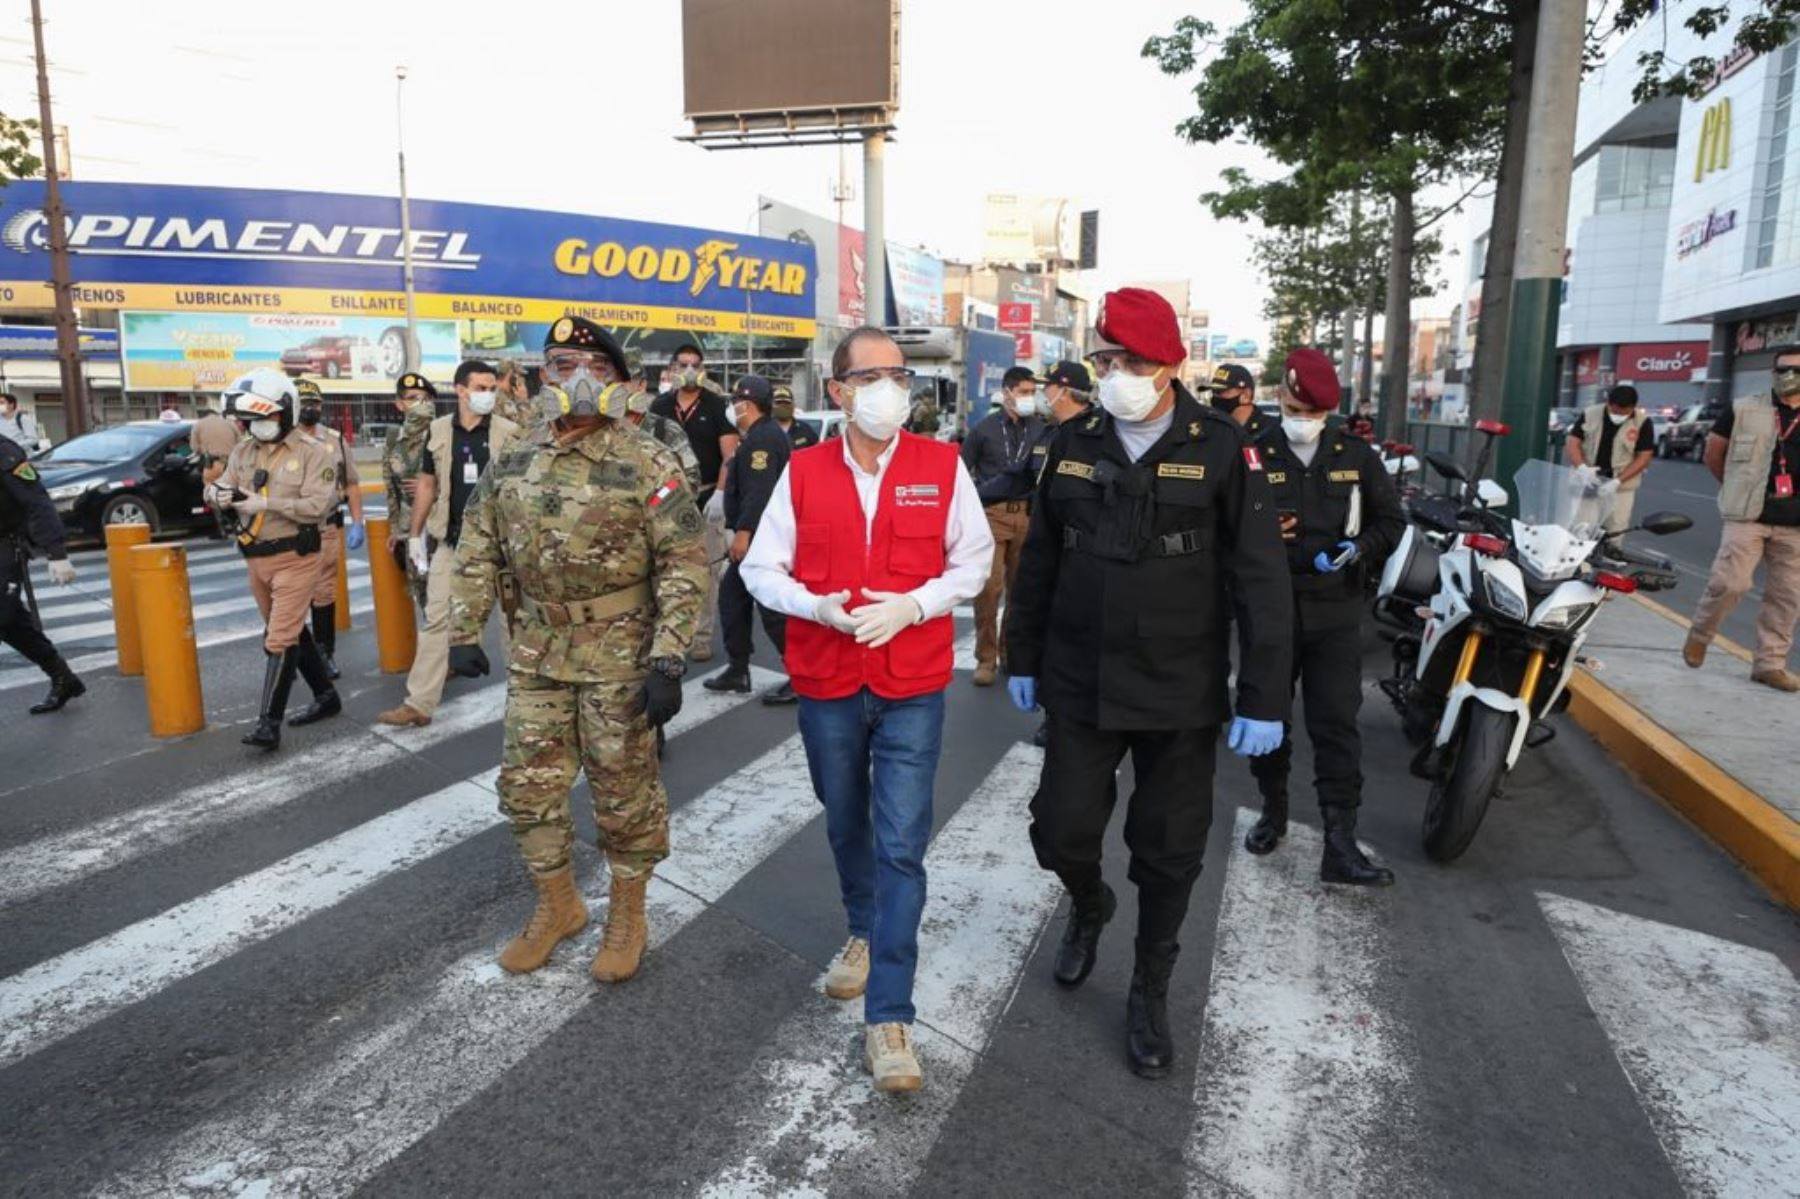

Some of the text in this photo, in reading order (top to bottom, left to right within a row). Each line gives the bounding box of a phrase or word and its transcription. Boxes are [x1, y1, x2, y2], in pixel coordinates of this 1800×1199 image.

[69, 215, 481, 262] PIMENTEL
[72, 287, 125, 303] RENOS
[175, 291, 282, 307] LUBRICANTES
[452, 301, 524, 316] BALANCEO
[563, 307, 649, 323] ALINEAMIENTO
[676, 313, 717, 327] FRENOS
[739, 318, 796, 333] LUBRICANTES
[1637, 356, 1683, 372] Claro
